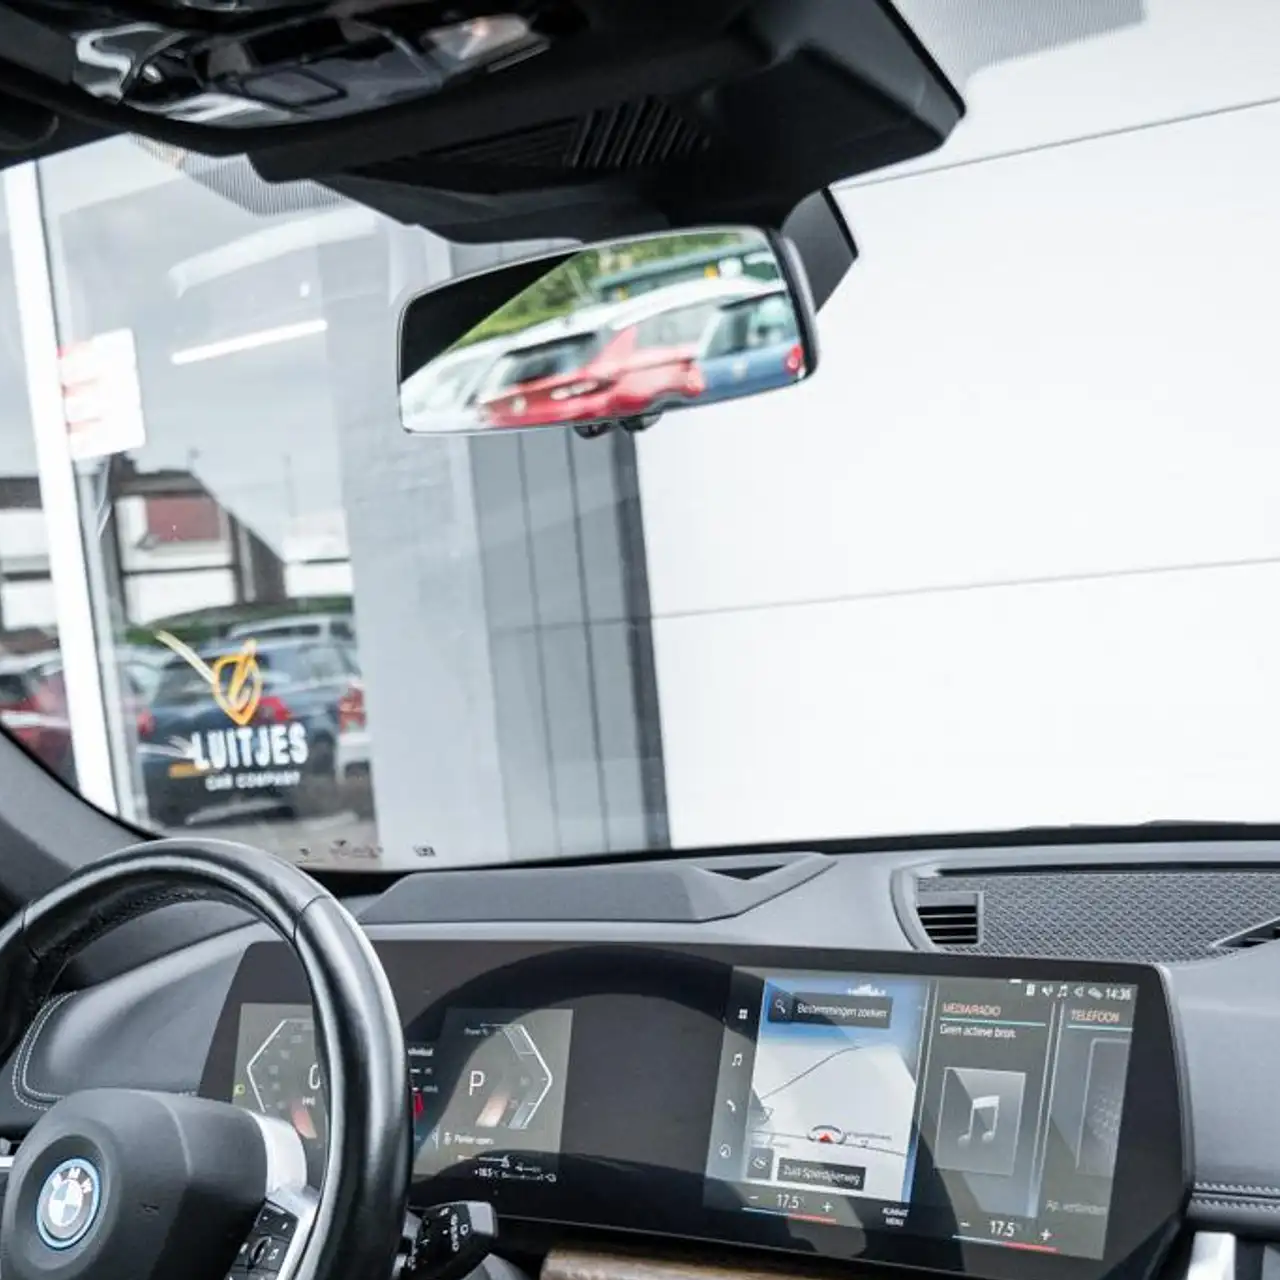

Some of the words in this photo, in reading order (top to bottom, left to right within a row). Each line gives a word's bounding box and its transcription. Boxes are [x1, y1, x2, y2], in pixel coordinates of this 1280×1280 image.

[191, 721, 308, 770] LUITJES
[235, 769, 300, 788] COMPANY
[797, 1003, 857, 1018] Bestemmingen
[1071, 1008, 1120, 1023] TELEFOON
[469, 1070, 486, 1096] P
